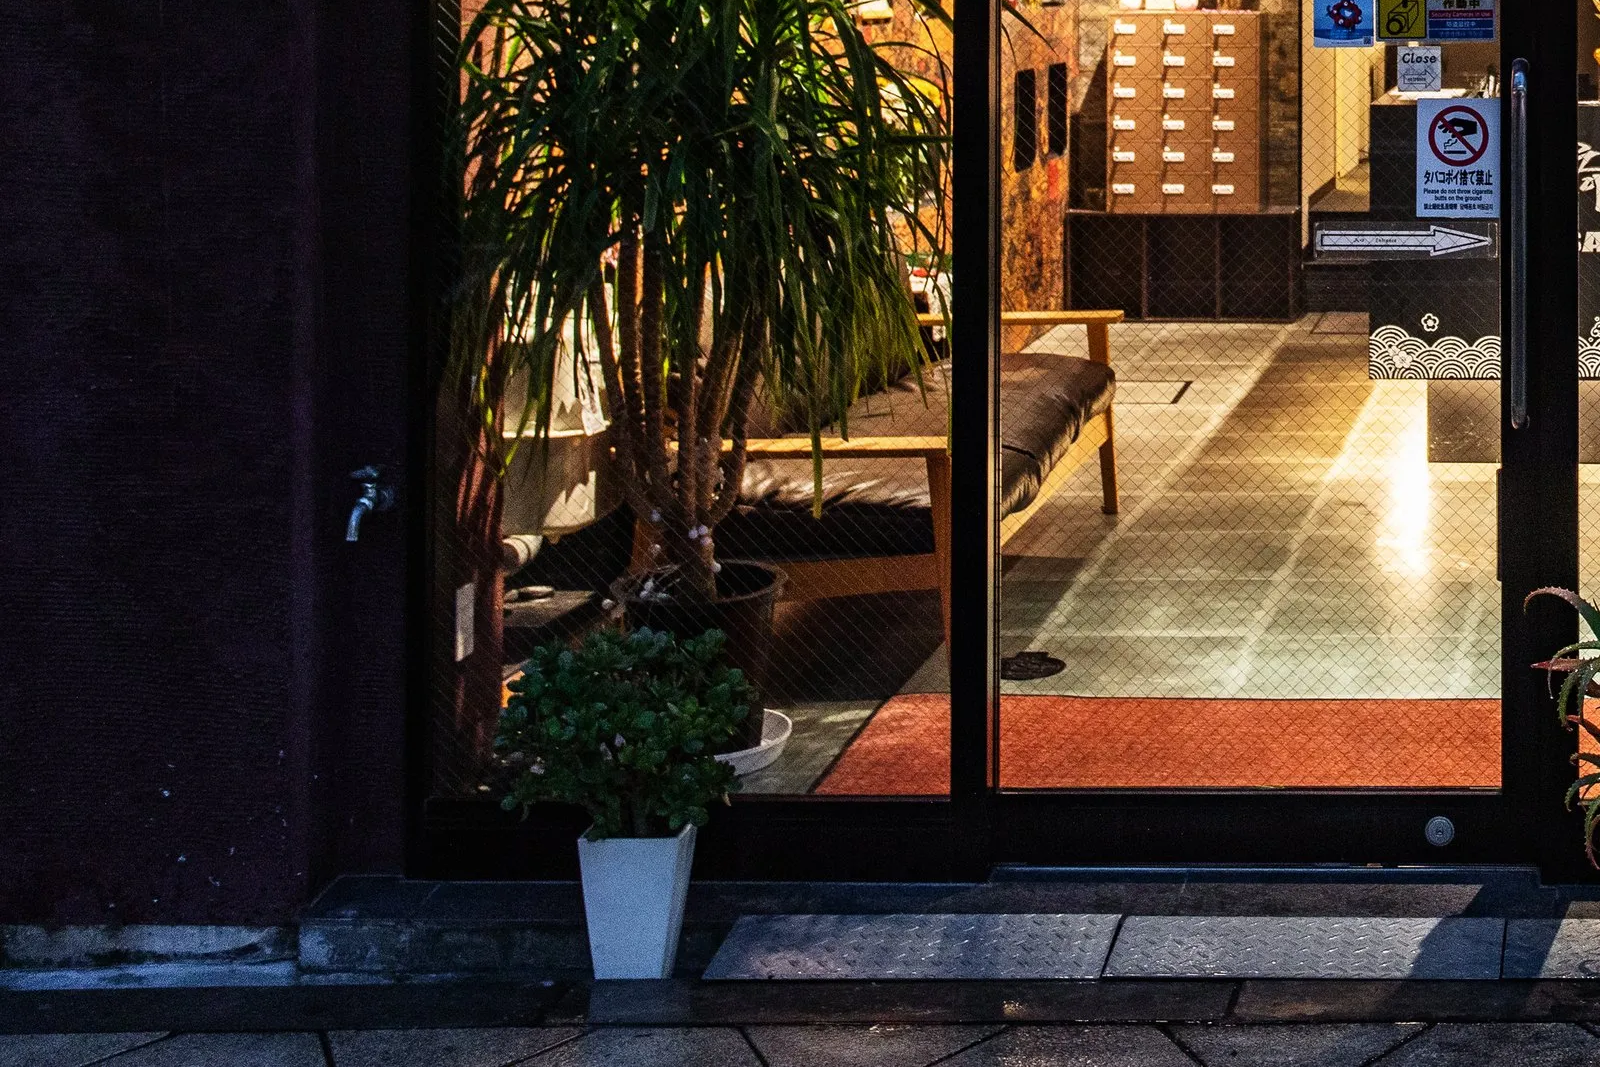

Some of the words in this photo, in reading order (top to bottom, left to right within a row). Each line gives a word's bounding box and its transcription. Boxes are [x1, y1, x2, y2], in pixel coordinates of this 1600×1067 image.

[1443, 0, 1480, 9] 作動中
[1402, 53, 1437, 64] Close
[1423, 169, 1493, 186] タバコポイ捨て禁止
[1423, 187, 1439, 195] Please
[1465, 195, 1483, 203] ground
